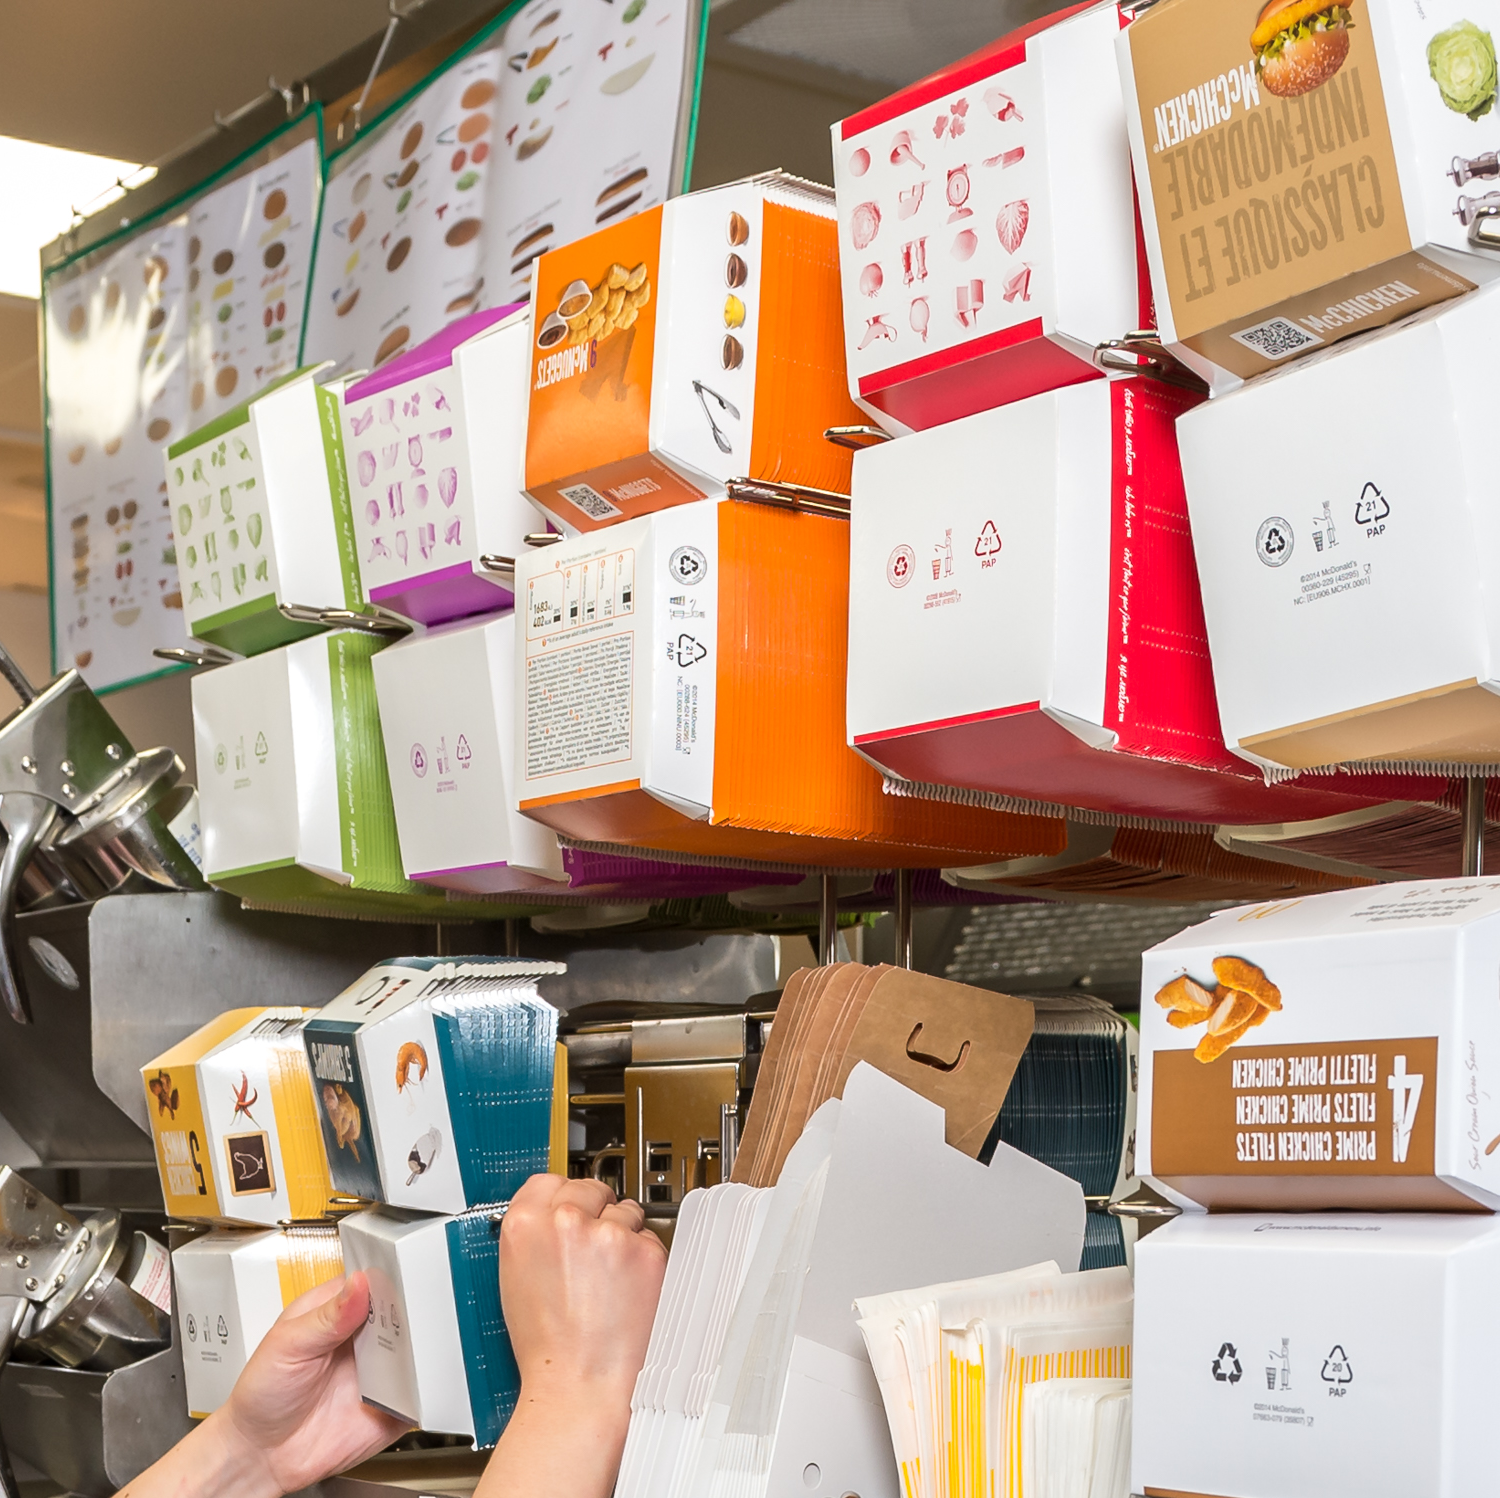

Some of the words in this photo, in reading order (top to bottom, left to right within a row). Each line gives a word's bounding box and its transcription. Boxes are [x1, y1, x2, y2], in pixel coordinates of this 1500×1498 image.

[1223, 155, 1385, 286] CLASSIQUE
[1181, 219, 1217, 302] ET
[1299, 280, 1420, 334] McCHICKEN
[1365, 501, 1376, 512] 21
[984, 537, 992, 546] 21
[1367, 525, 1386, 539] PAP
[981, 558, 996, 569] PAP
[1300, 572, 1320, 583] ©2014
[1321, 560, 1357, 576] McDonald's
[685, 645, 693, 656] 21
[1330, 1053, 1376, 1085] FILETTI
[1464, 1039, 1478, 1071] Sauce
[1232, 1057, 1285, 1088] CHICKEN
[1287, 1055, 1327, 1087] PRIME
[1465, 1075, 1478, 1105] Onion
[1236, 1094, 1288, 1125] CHICKEN
[1291, 1093, 1331, 1124] PRIME
[1334, 1092, 1376, 1123] FILETS
[1387, 1055, 1424, 1162] 4
[1467, 1108, 1479, 1142] Cream
[1236, 1132, 1275, 1162] FILETS
[1278, 1130, 1332, 1161] CHICKEN
[1335, 1130, 1376, 1161] PRIME
[1468, 1144, 1481, 1170] Sour
[189, 1130, 207, 1196] 5
[1332, 1363, 1343, 1372] 20
[1329, 1387, 1346, 1397] PAP
[1272, 1404, 1305, 1414] McDonald's
